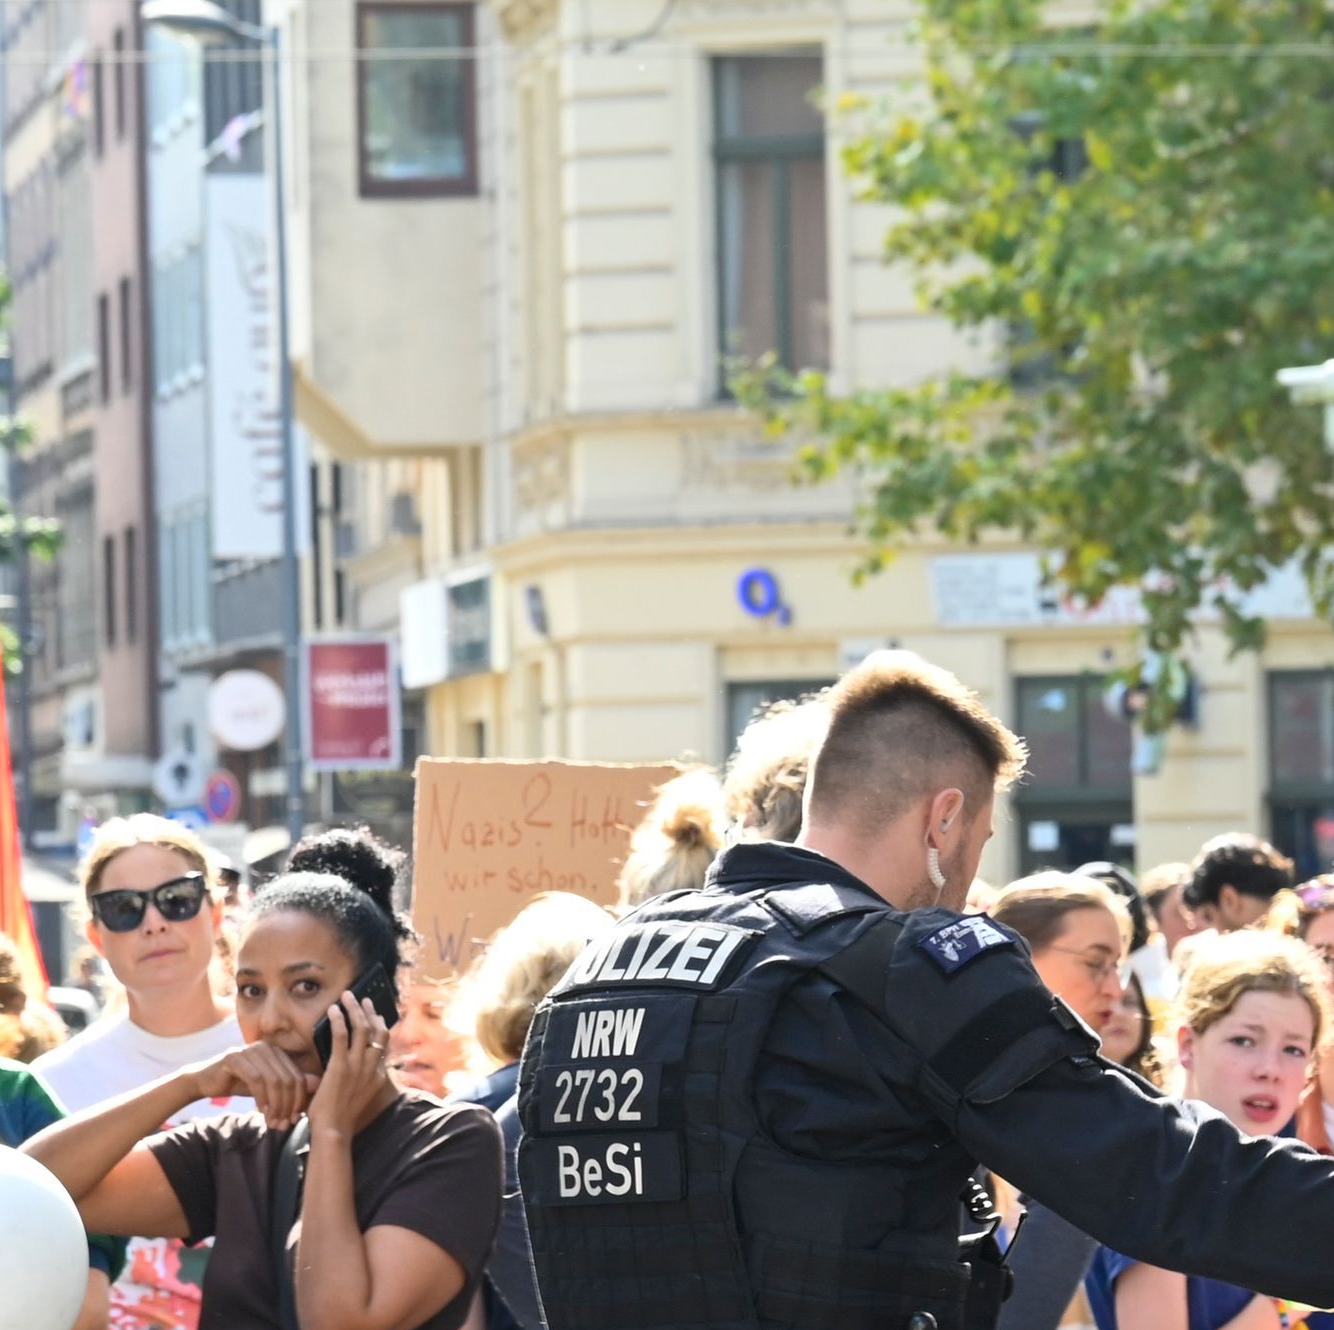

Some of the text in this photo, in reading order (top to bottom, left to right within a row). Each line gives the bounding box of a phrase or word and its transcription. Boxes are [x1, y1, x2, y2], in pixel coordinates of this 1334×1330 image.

[427, 771, 554, 854] Nazis?
[445, 864, 497, 892] wir
[570, 1007, 646, 1059] NRW
[553, 1068, 644, 1124] 2732
[557, 1142, 644, 1199] BeSi
